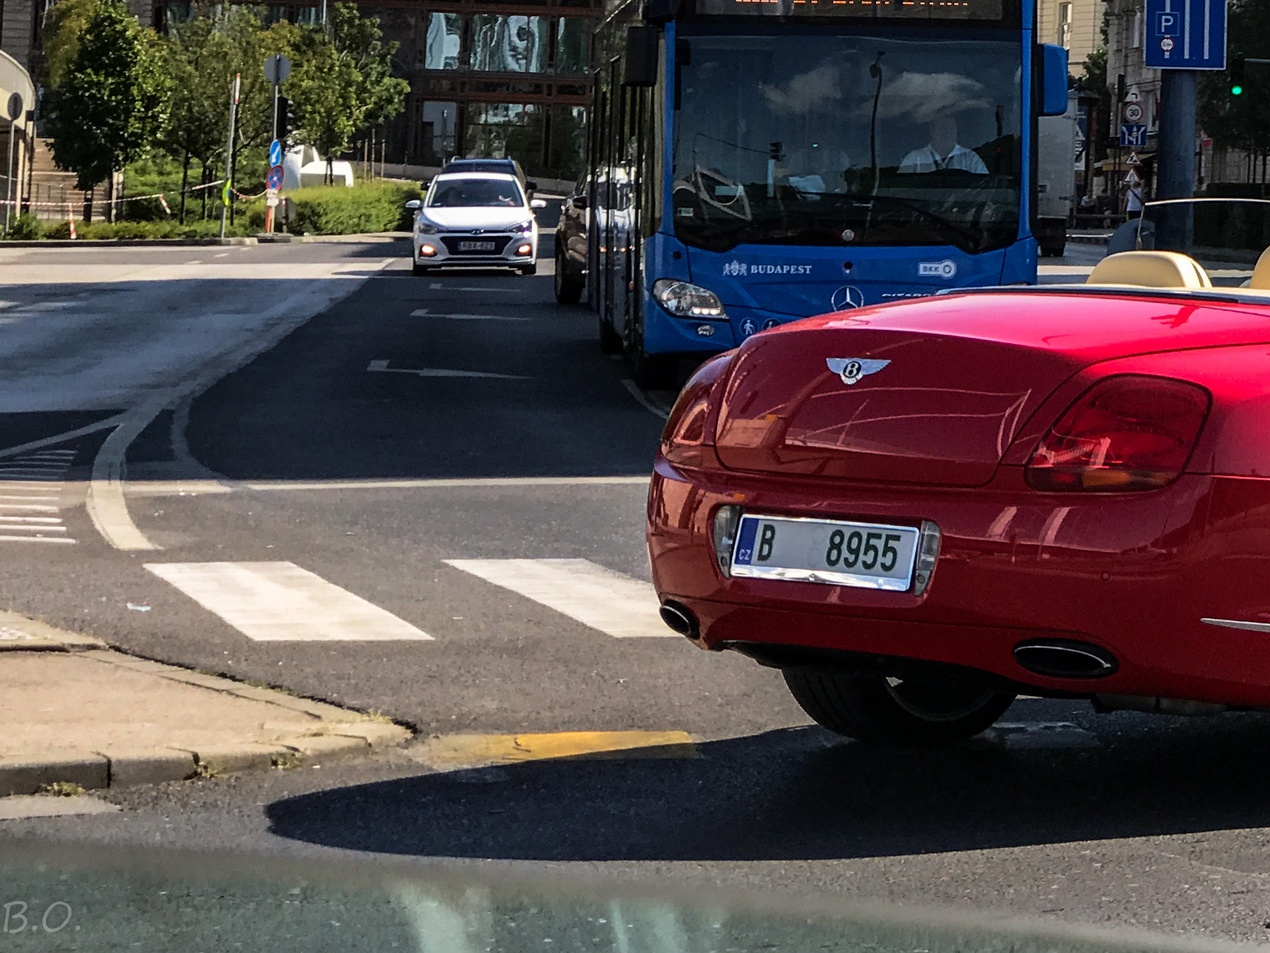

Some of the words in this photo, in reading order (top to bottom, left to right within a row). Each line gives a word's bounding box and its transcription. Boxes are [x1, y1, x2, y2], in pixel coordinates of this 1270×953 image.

[1161, 15, 1174, 32] P
[1129, 109, 1139, 117] 30
[750, 264, 812, 274] BUDAPEST
[738, 549, 750, 561] CZ
[757, 524, 776, 562] B
[825, 529, 902, 573] 8955
